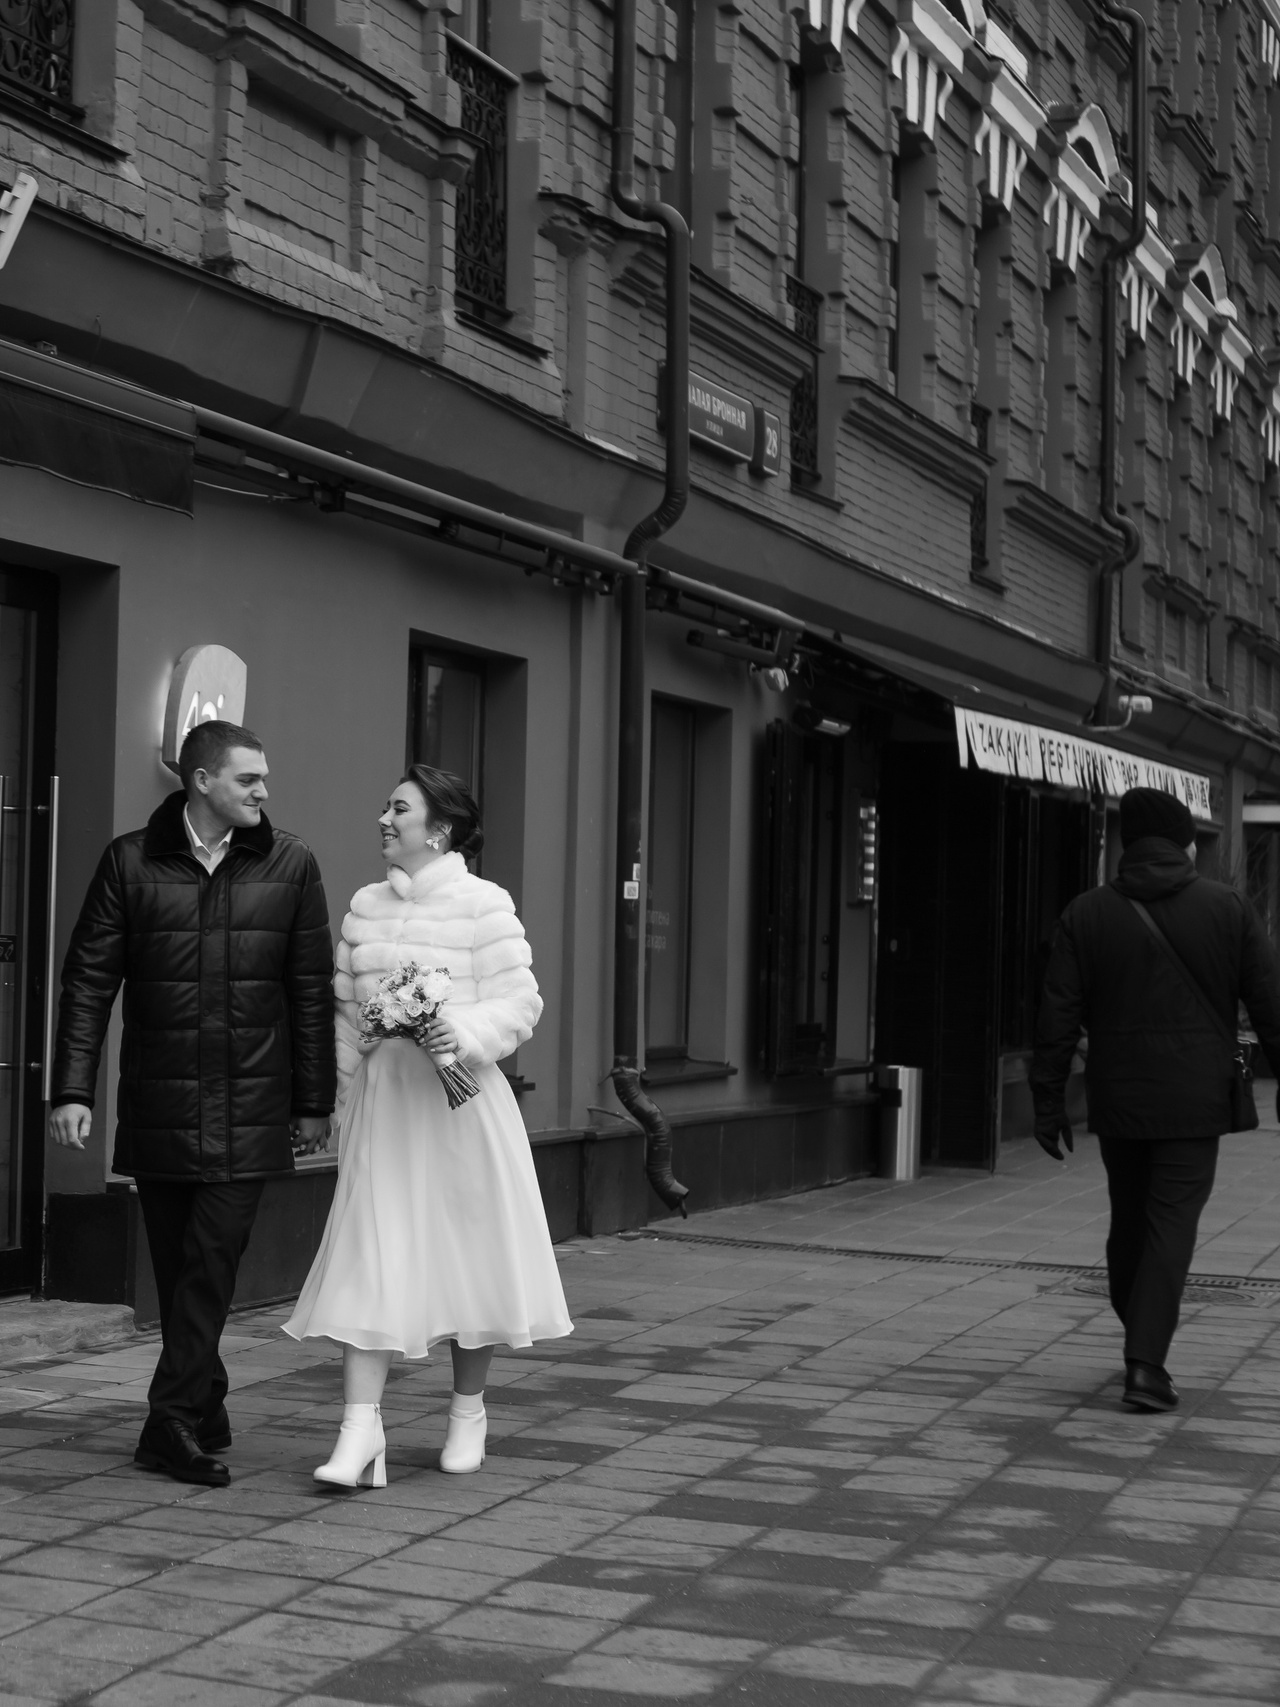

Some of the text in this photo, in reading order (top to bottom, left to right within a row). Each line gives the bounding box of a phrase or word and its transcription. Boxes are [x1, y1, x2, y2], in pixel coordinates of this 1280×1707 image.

[712, 396, 746, 431] БРОННАЯ
[766, 426, 778, 459] 28
[969, 721, 1032, 764] IZAKAYA
